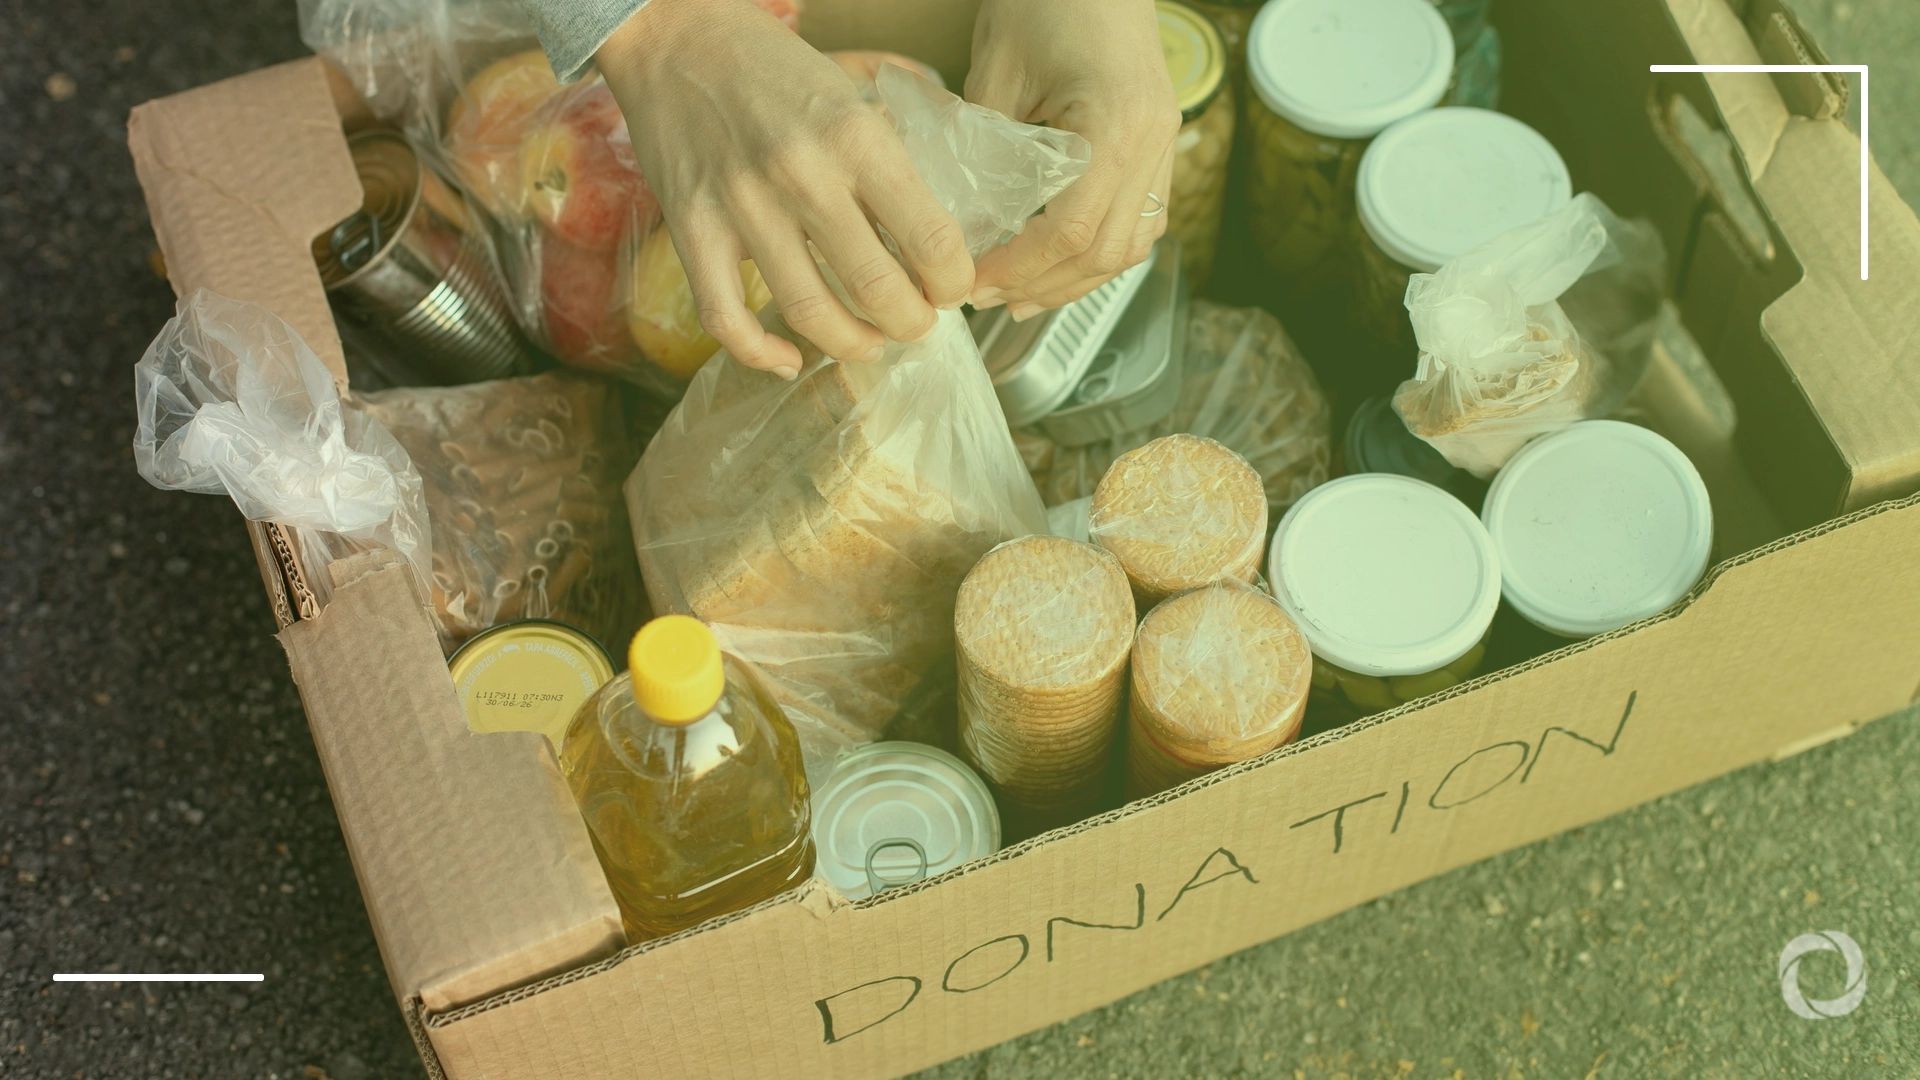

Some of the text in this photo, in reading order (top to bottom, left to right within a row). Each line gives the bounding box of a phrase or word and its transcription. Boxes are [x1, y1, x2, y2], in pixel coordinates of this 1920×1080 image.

[524, 642, 543, 652] TAPA
[476, 691, 564, 702] L117911 07:30N3
[486, 699, 533, 709] 30/06/26
[814, 690, 1637, 1045] DONATION
